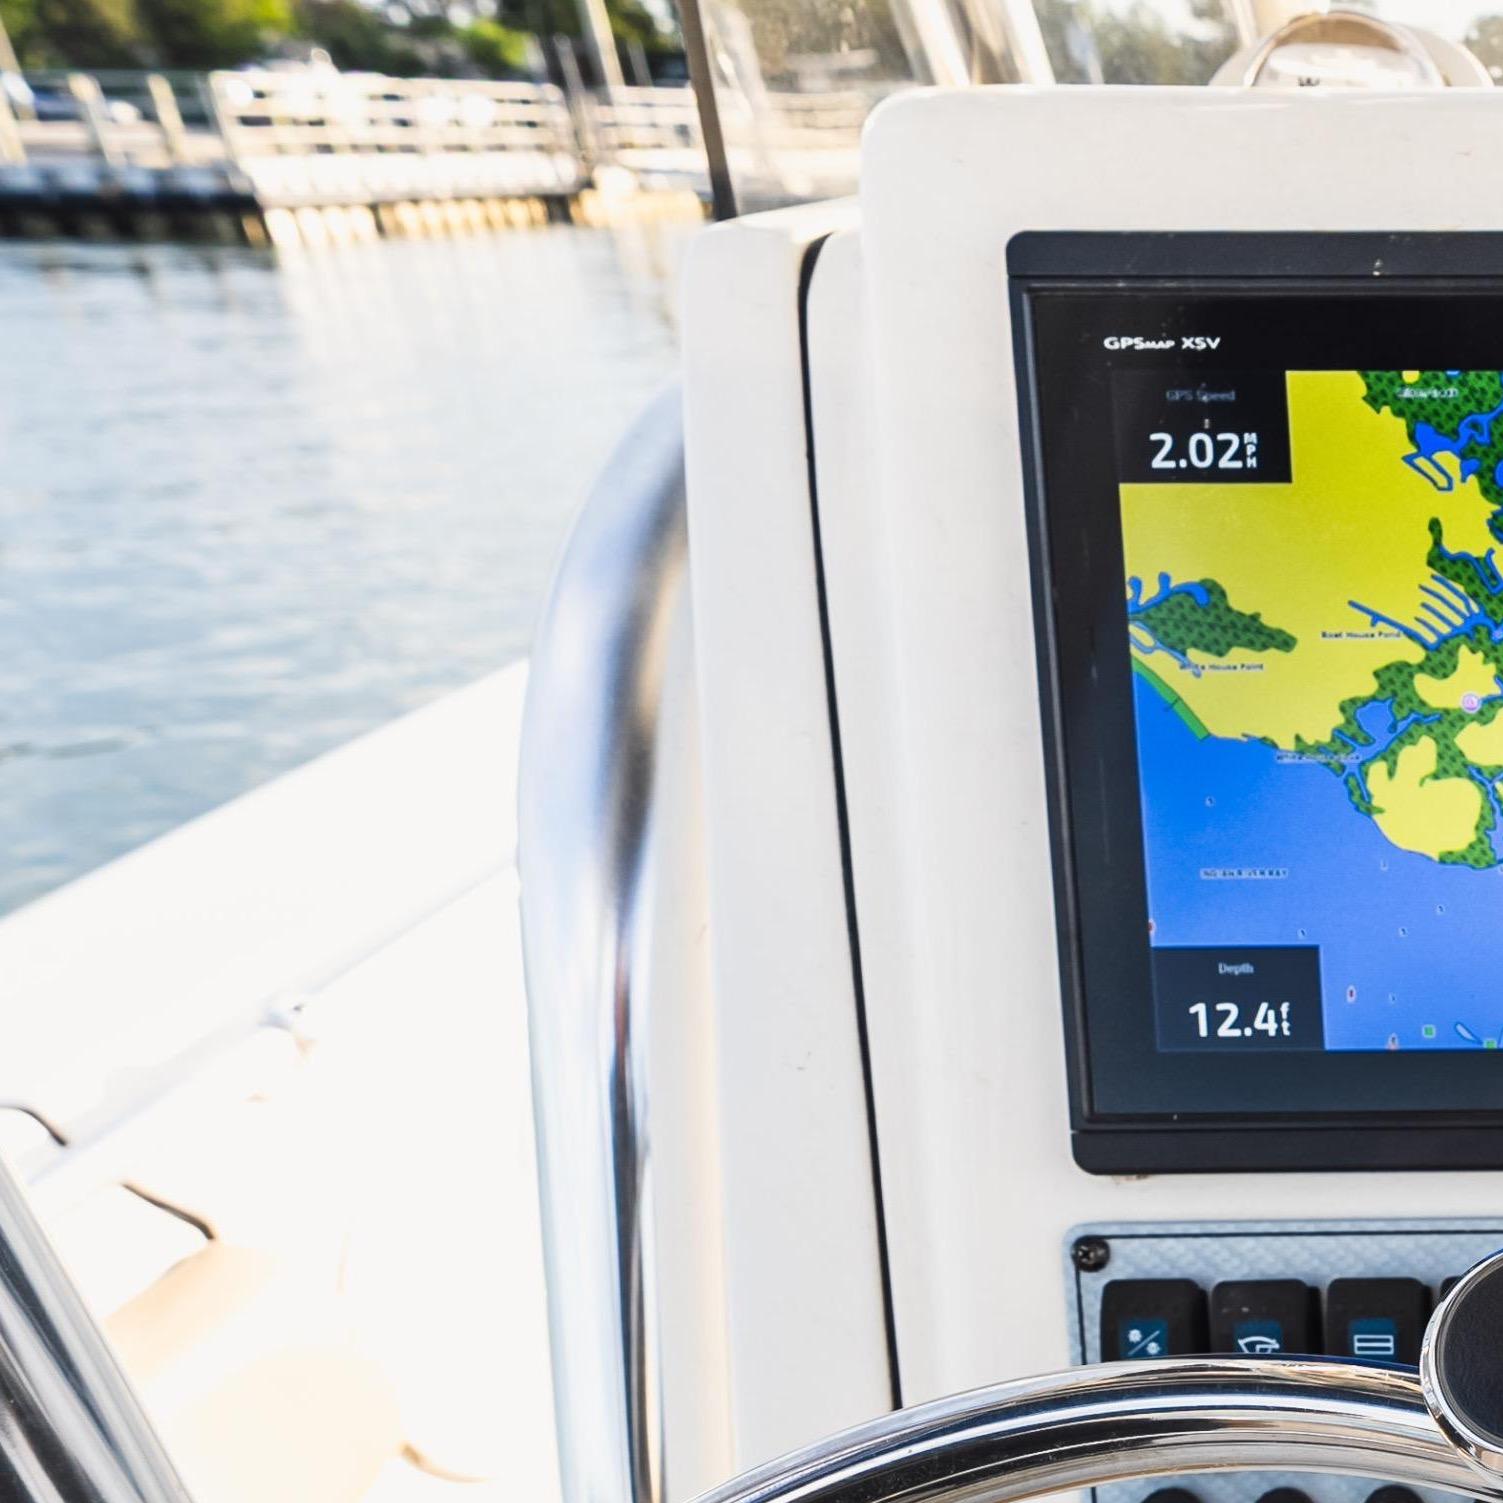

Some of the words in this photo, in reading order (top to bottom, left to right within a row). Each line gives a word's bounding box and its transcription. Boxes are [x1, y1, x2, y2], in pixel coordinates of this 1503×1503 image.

[1181, 336, 1221, 350] XSV
[1149, 431, 1243, 469] 2.02
[1217, 962, 1254, 976] Depth
[1188, 1001, 1279, 1038] 12.4
